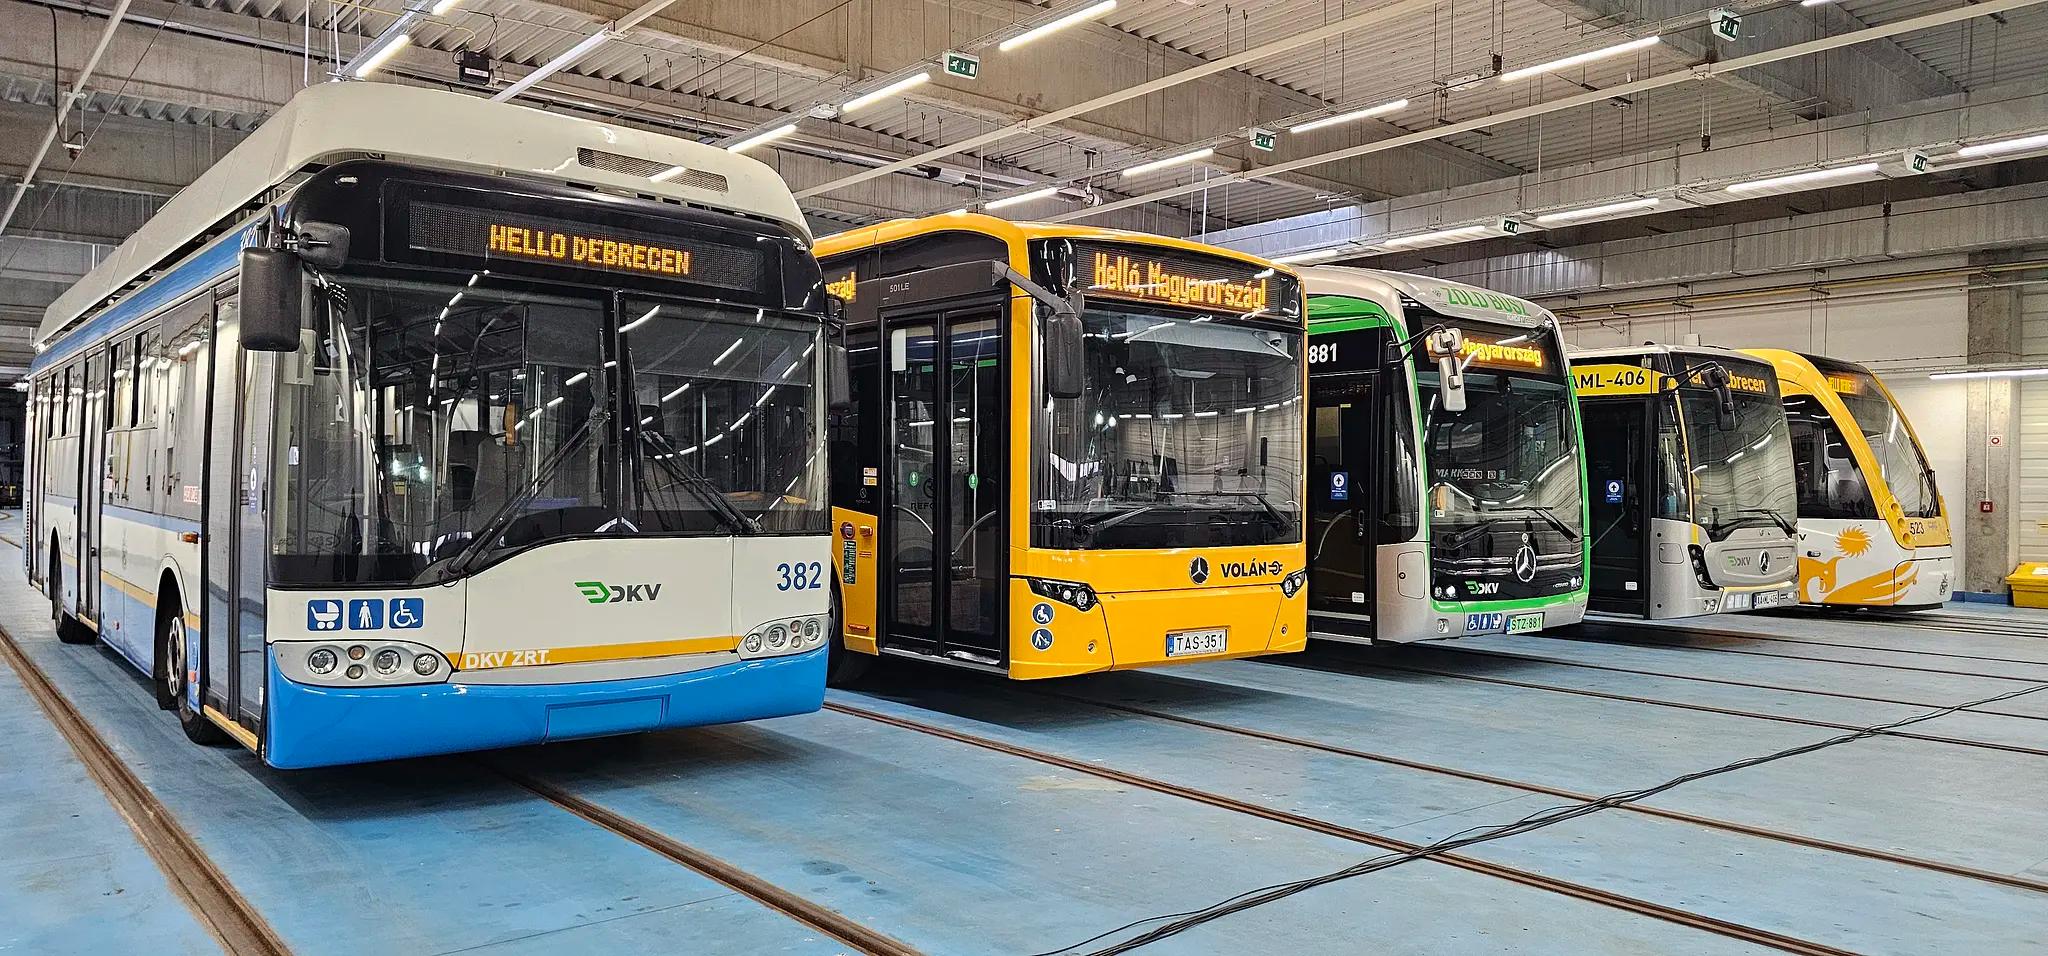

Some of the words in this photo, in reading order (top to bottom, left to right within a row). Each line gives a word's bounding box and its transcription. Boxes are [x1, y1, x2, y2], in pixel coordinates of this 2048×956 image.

[490, 225, 566, 257] HELLO
[573, 236, 689, 274] DEBRECEN
[1095, 253, 1142, 296] Helló,
[1148, 261, 1266, 311] Magyarország!
[1308, 342, 1337, 364] 881
[1909, 522, 1925, 535] 523
[776, 561, 823, 592] 382
[1220, 558, 1267, 578] VOLÁN
[609, 583, 663, 603] DKV
[1478, 583, 1499, 595] DKV
[1176, 634, 1223, 651] TAS-351
[465, 651, 507, 669] DKV
[511, 649, 550, 666] ZRT.
